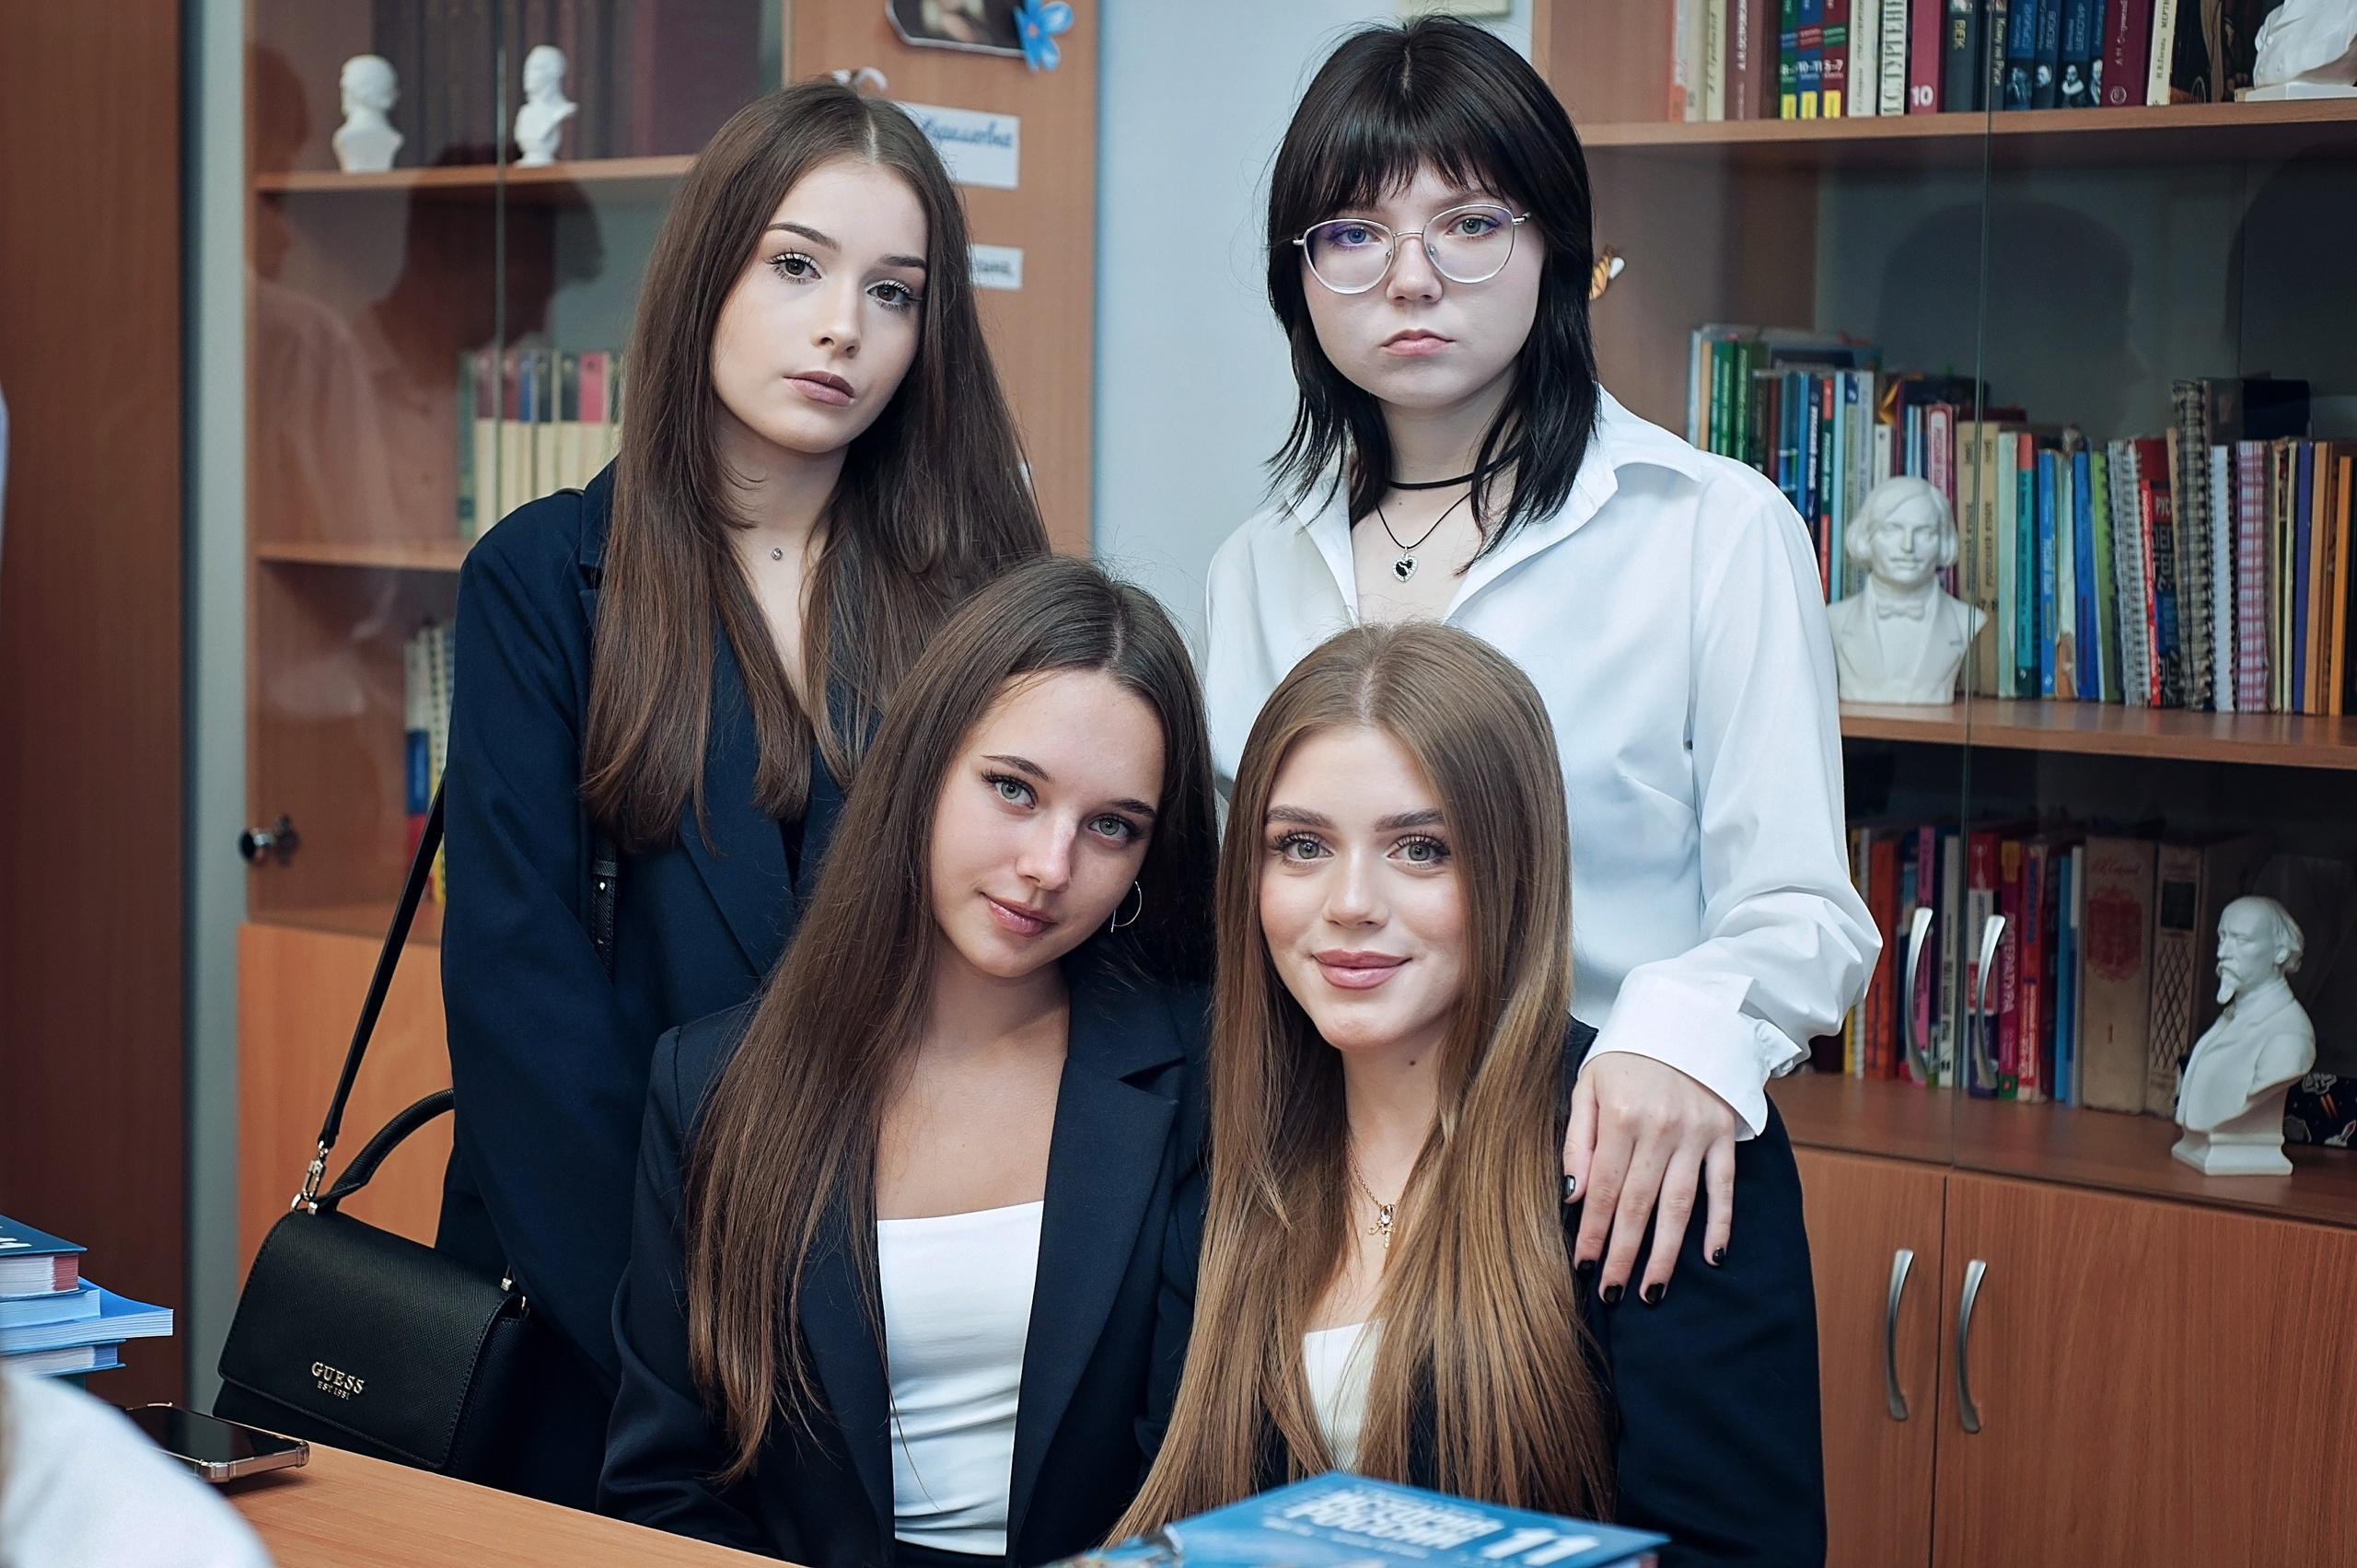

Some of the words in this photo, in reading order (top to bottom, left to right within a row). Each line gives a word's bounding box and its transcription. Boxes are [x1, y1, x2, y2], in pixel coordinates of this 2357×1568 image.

[1953, 18, 1966, 51] ВЕК
[1910, 85, 1934, 108] 10
[311, 1361, 366, 1395] GUESS
[1480, 1527, 1600, 1566] 11
